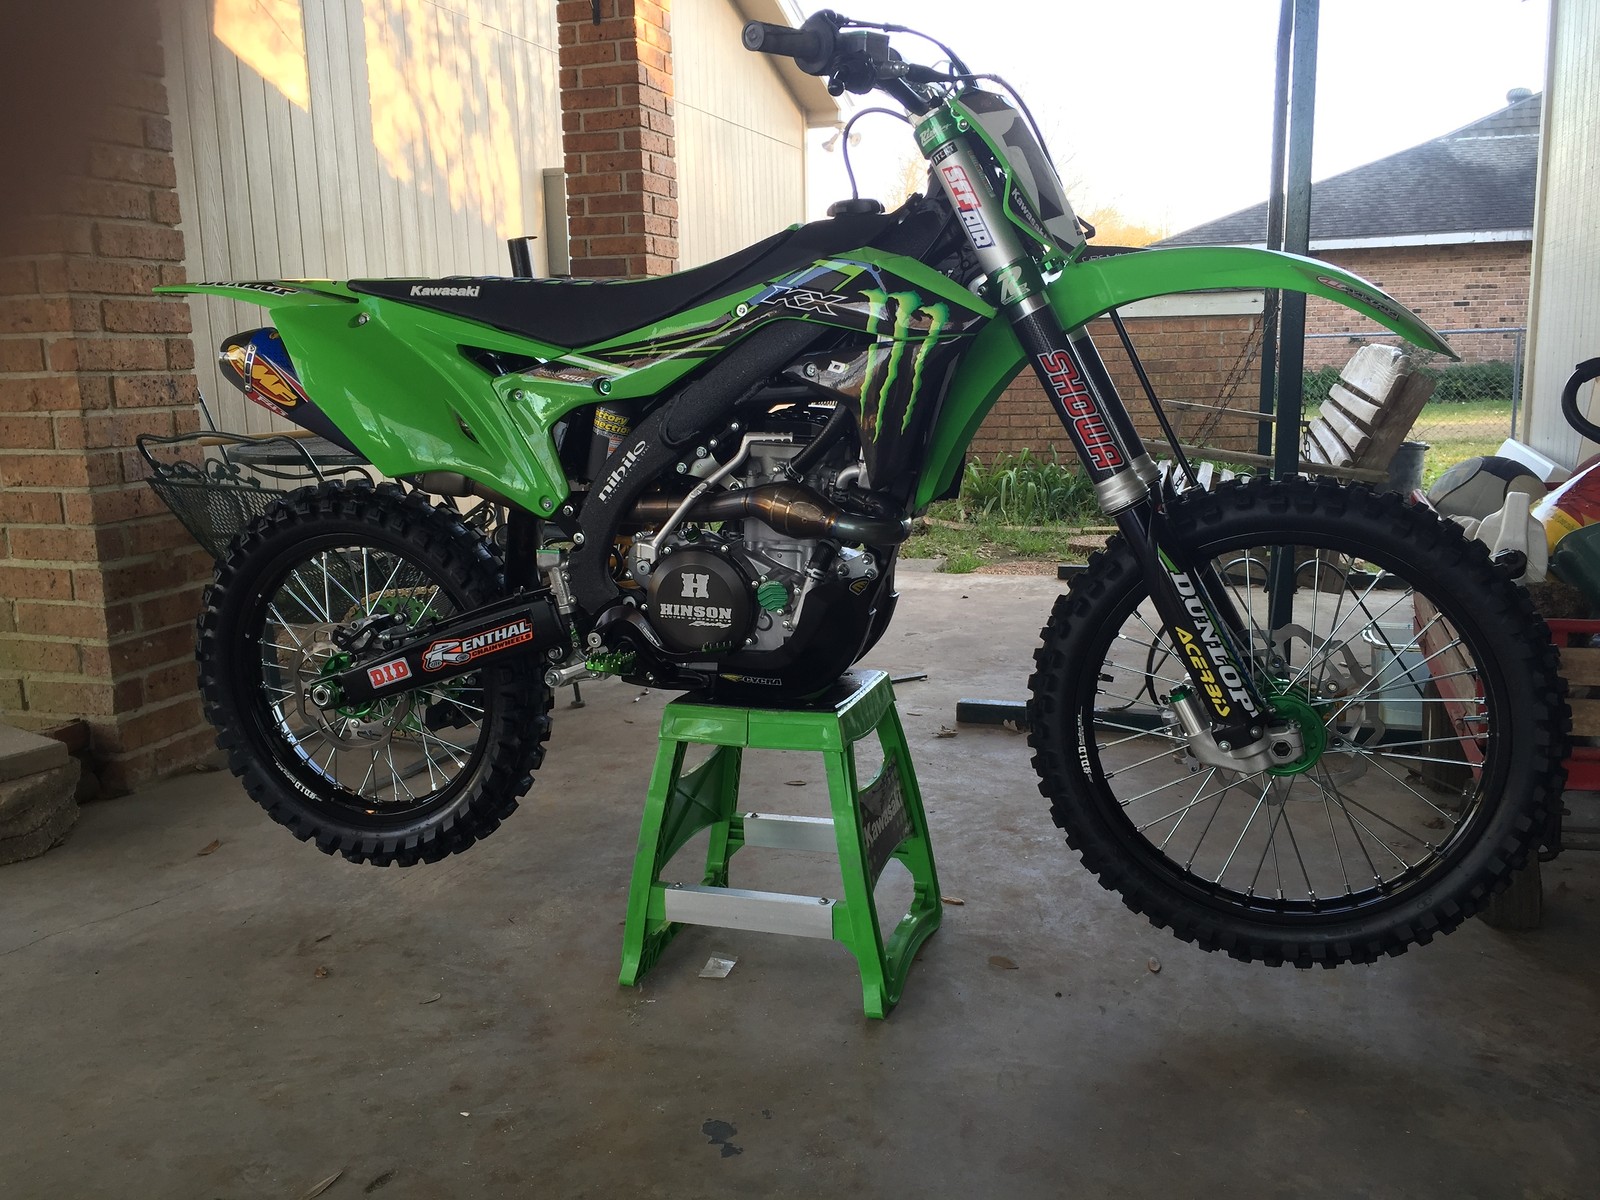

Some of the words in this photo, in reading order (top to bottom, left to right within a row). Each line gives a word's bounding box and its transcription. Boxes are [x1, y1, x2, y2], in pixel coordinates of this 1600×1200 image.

[941, 165, 982, 212] SFF
[957, 206, 996, 250] AIR
[1011, 187, 1048, 239] Kawasaki
[409, 285, 480, 297] Kawasaki
[1037, 349, 1125, 471] SHOWA
[598, 440, 646, 502] nihilo
[681, 573, 710, 599] H
[660, 603, 732, 620] HINSON
[424, 621, 532, 669] RENTHAL
[471, 633, 532, 657] CHAINWHEELS
[1170, 572, 1260, 719] DUNLOP
[863, 789, 904, 849] Kawasaki
